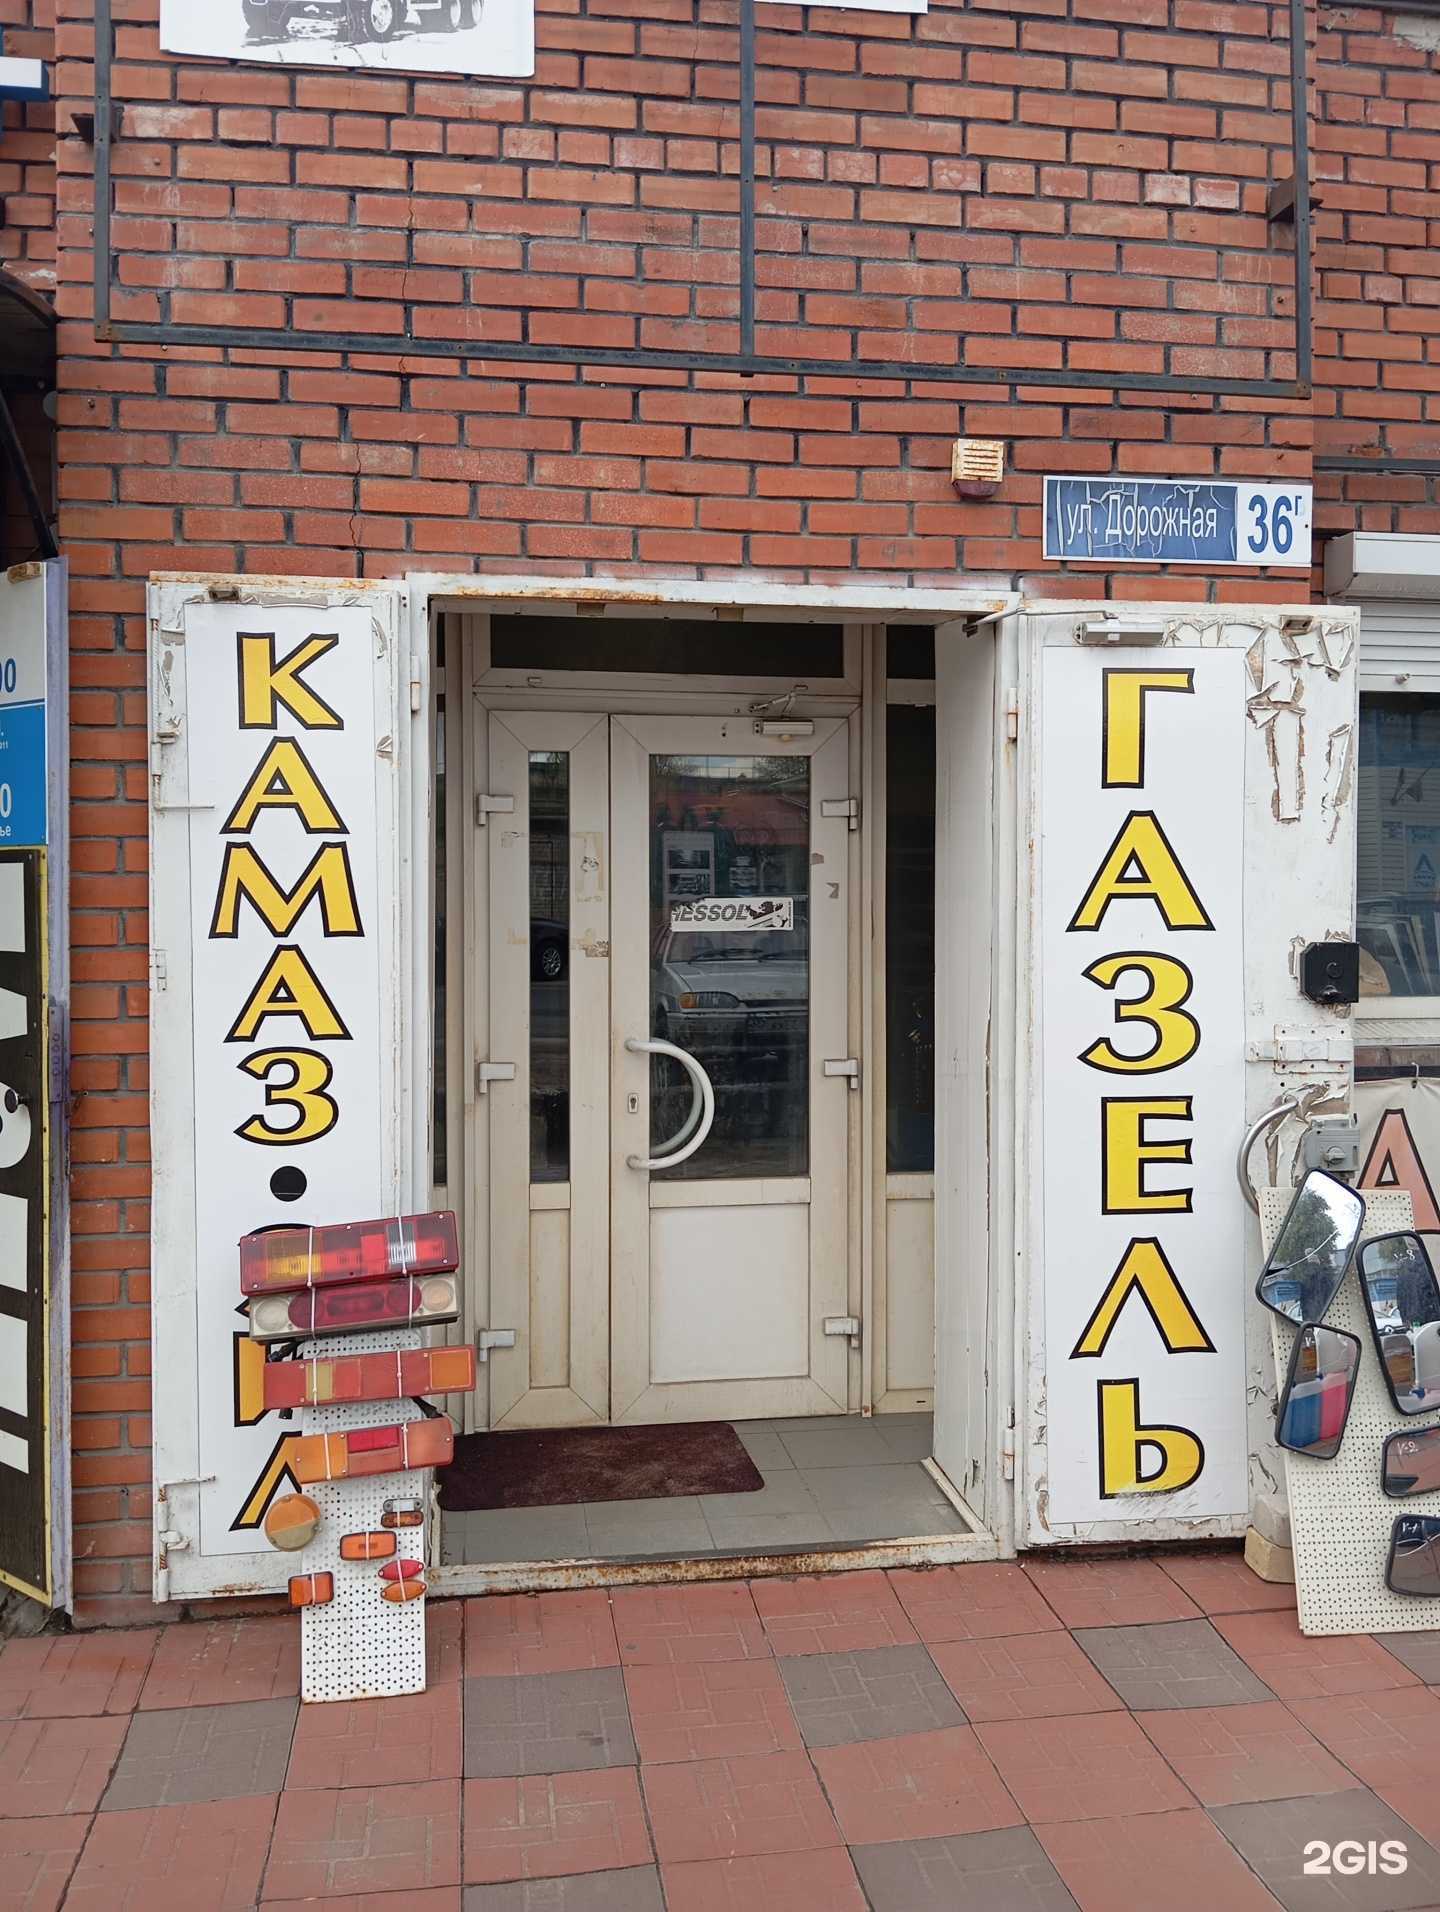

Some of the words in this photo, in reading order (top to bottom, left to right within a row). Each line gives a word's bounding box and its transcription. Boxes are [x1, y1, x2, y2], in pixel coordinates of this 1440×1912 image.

[1066, 503, 1098, 545] ул.
[1105, 494, 1217, 546] Дорожная
[208, 632, 366, 1146] КАМАЗ
[1066, 667, 1218, 1500] ГАЗЕЛЬ
